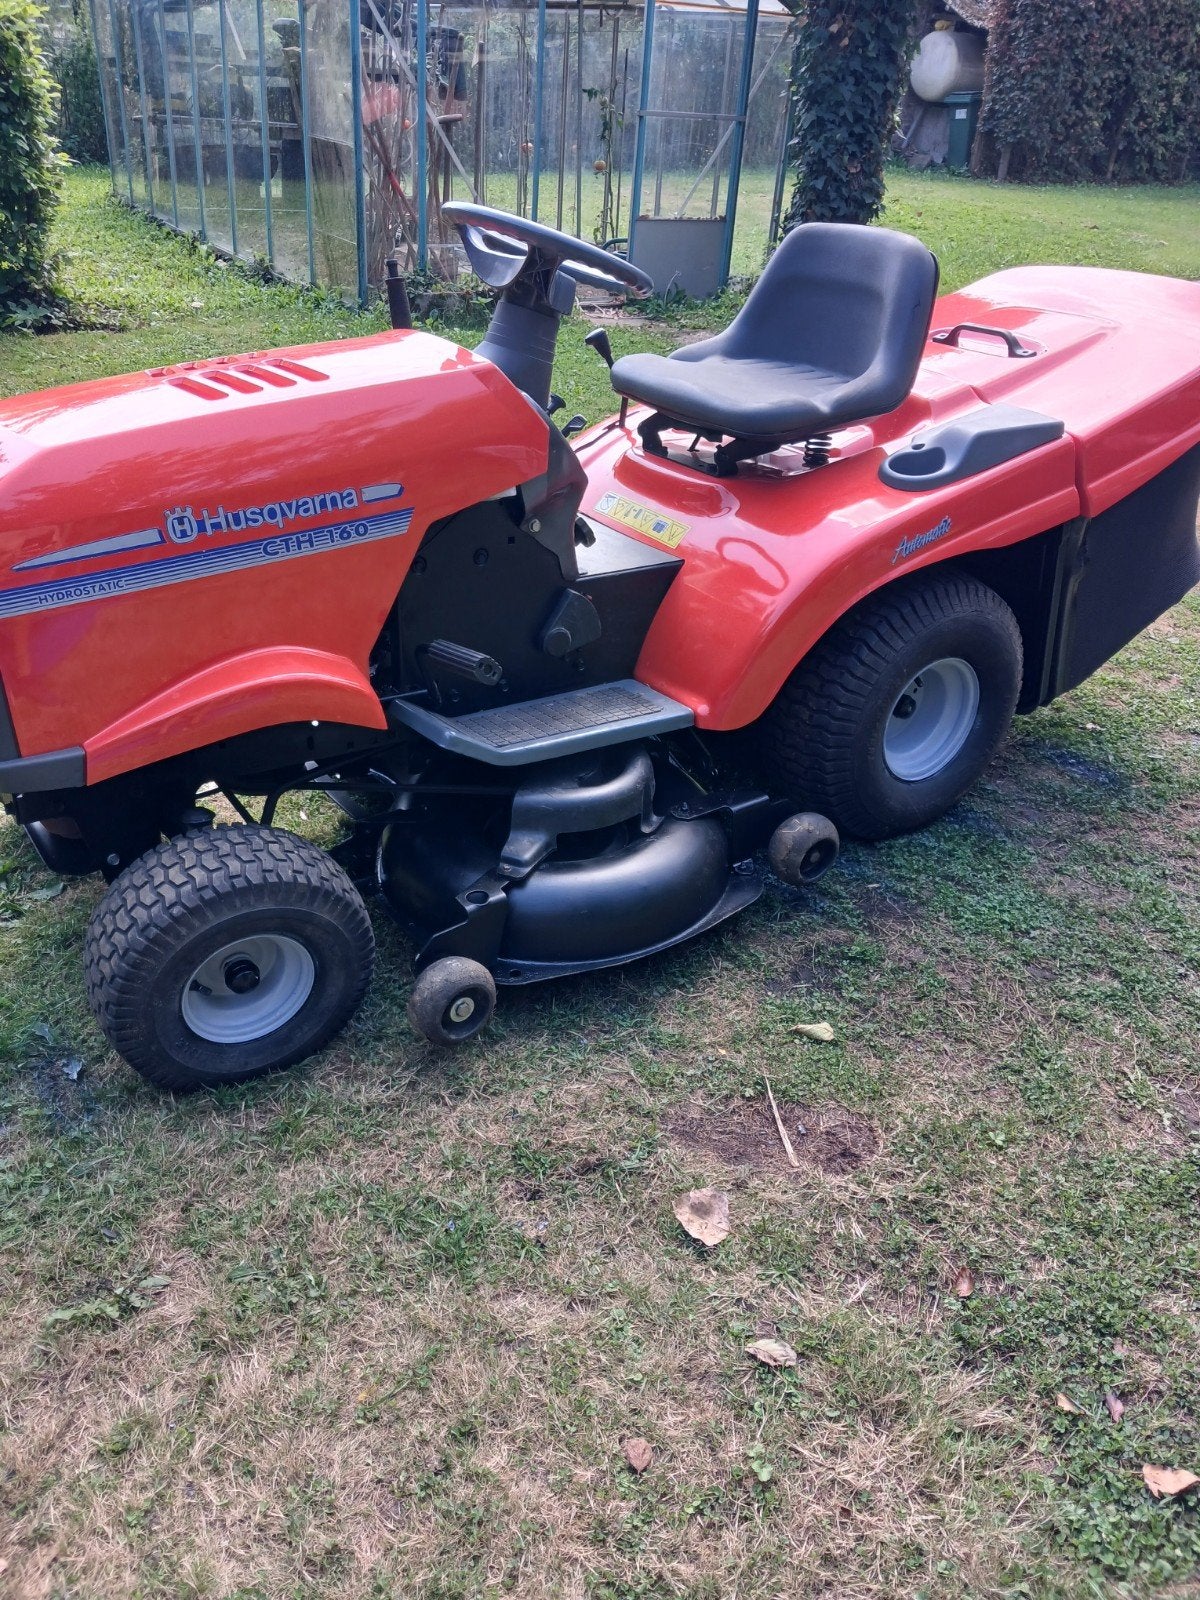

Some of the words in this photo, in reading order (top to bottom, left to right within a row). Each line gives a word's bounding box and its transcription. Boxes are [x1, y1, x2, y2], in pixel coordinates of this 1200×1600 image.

[203, 487, 359, 535] Husqvarna
[262, 531, 315, 557] CTH
[328, 521, 370, 545] 160
[891, 514, 952, 565] Automatic
[37, 579, 125, 605] HYDROSTATIC
